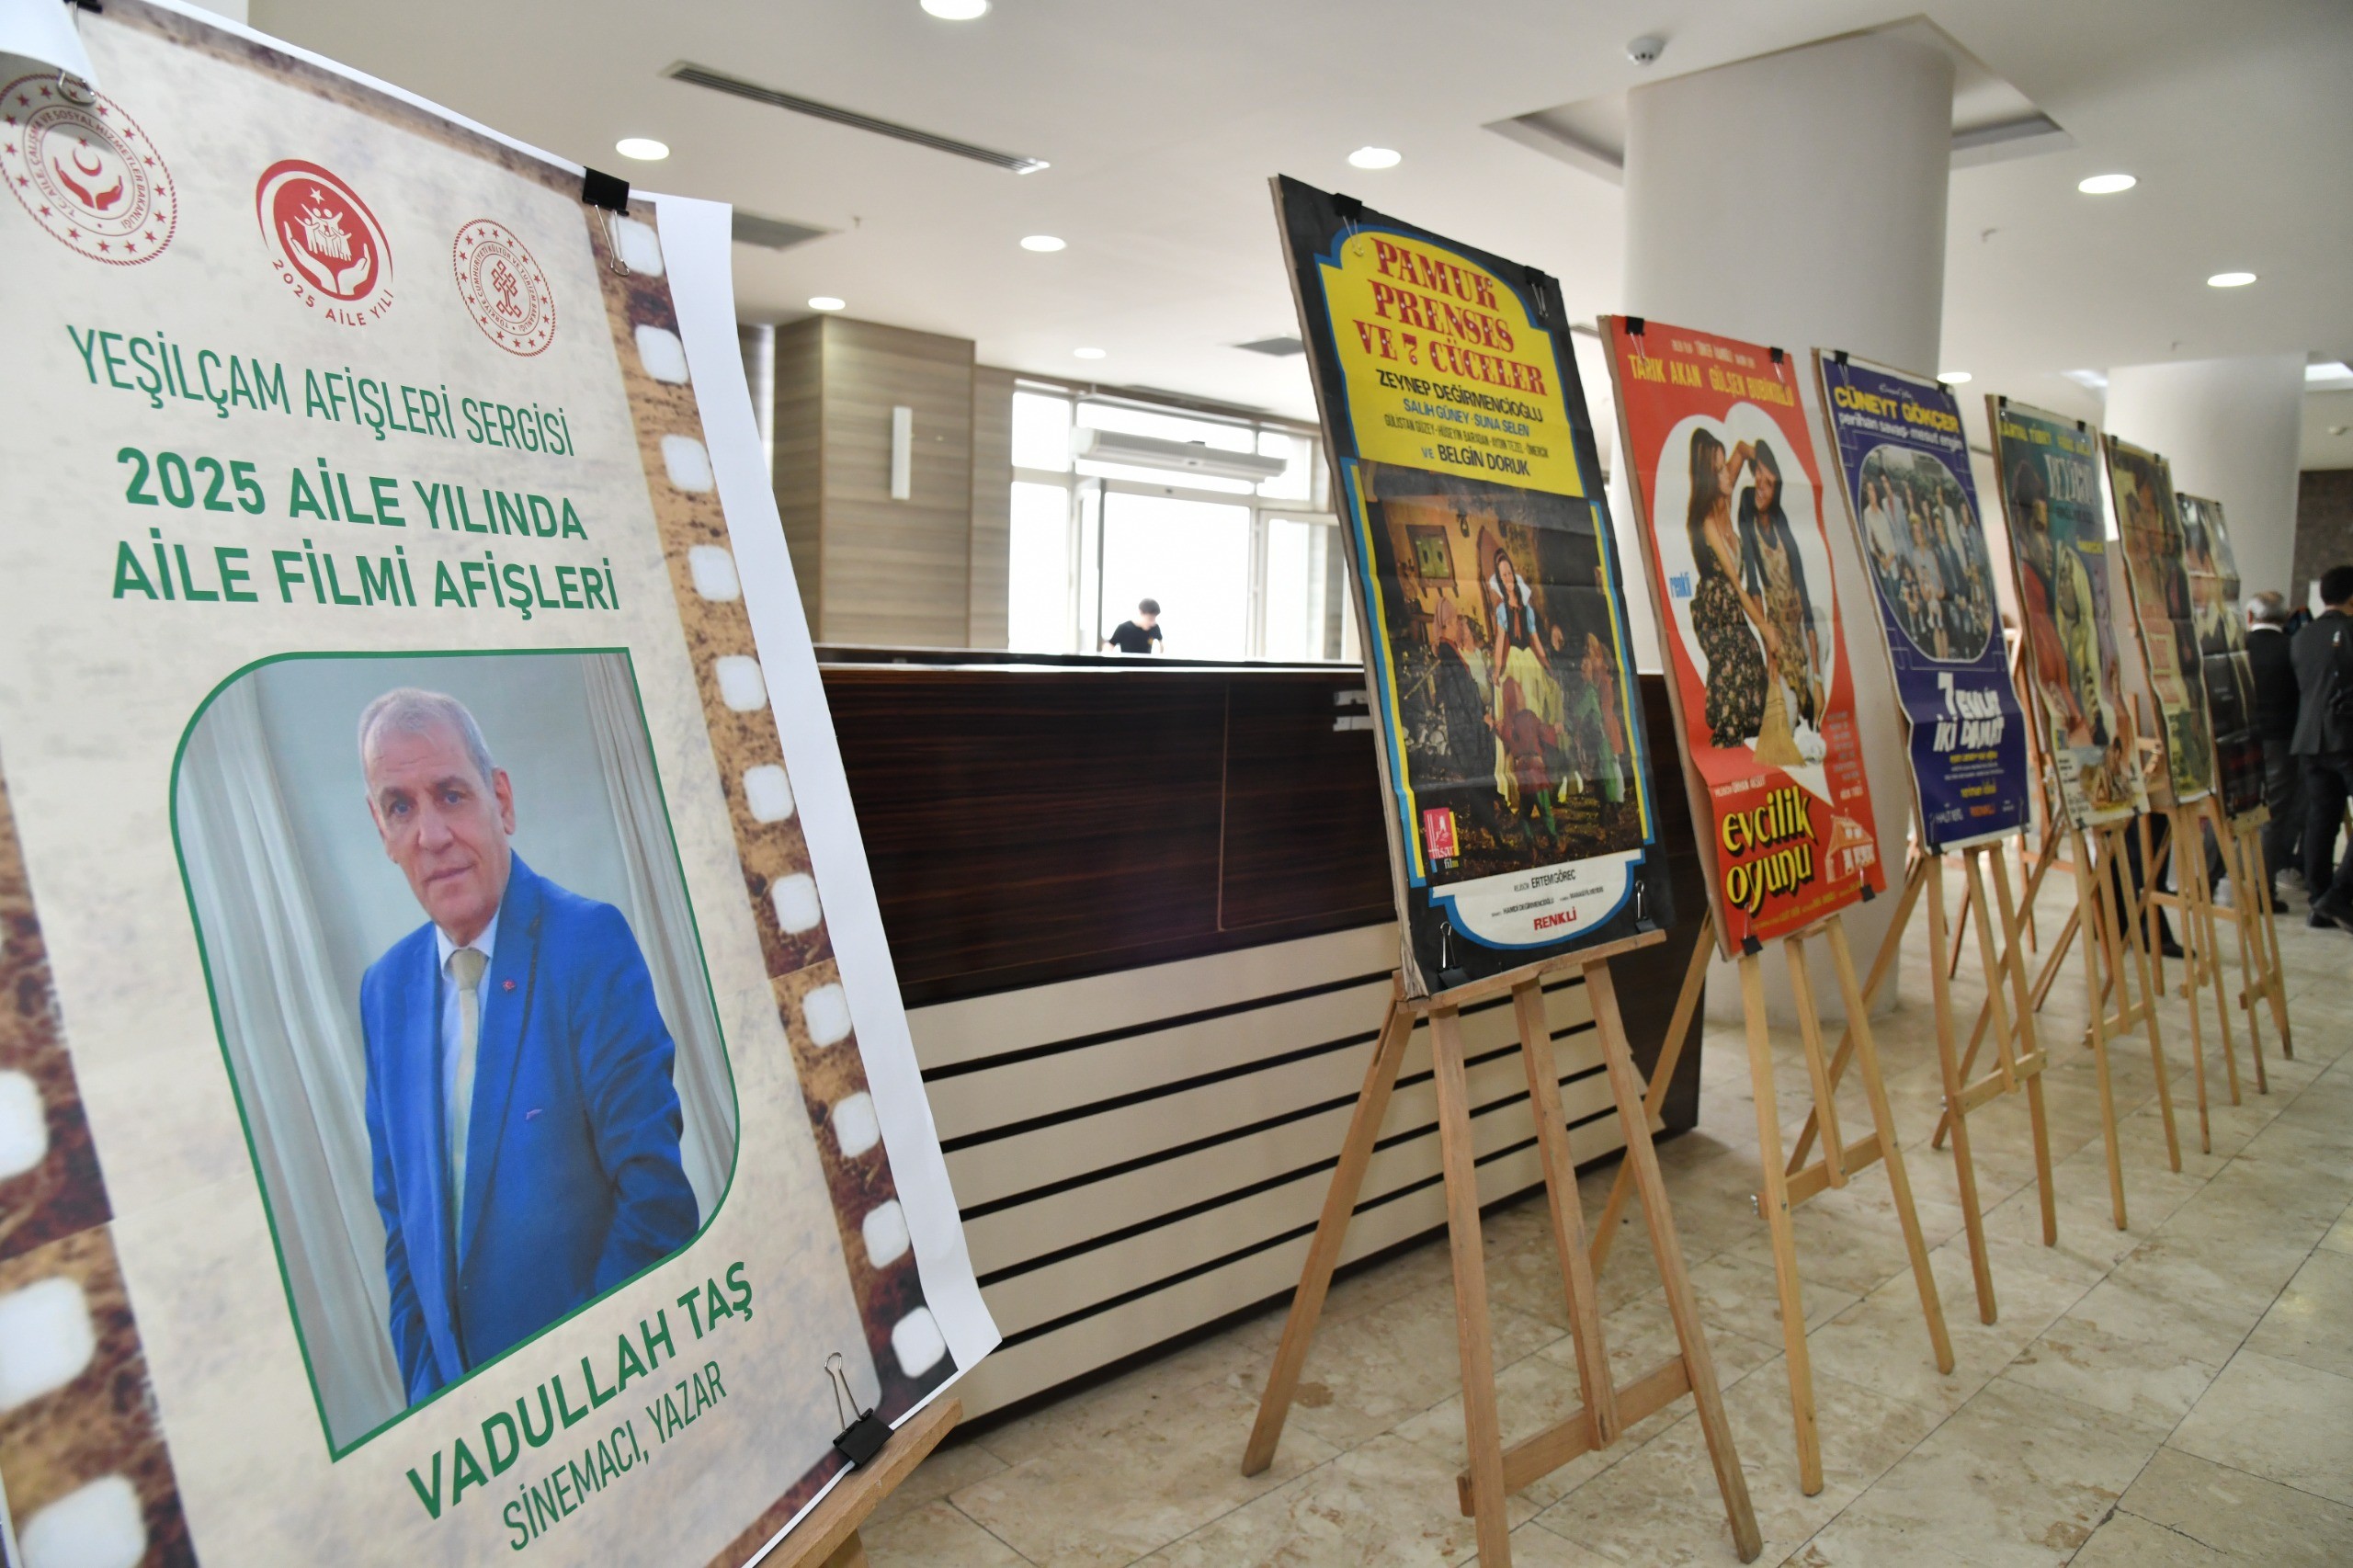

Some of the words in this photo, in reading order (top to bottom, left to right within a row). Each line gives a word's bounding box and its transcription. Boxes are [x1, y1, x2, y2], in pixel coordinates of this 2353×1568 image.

[53, 109, 94, 129] SOSYAL
[96, 124, 143, 181] HİZMETLER
[120, 182, 147, 229] BAKANLIĞI
[272, 259, 315, 308] 2025
[325, 308, 367, 326] AİLE
[369, 289, 394, 319] YILI
[1370, 237, 1499, 311] PAMUK
[1367, 278, 1515, 353] PRENSES
[66, 324, 291, 419] YEŞİLÇAM
[305, 366, 457, 441] AFİŞLERİ
[461, 397, 574, 456] SERGİSİ
[1353, 319, 1398, 362] VE
[1403, 332, 1419, 366] 7
[1427, 338, 1548, 396] CÜCELER
[1627, 354, 1666, 383] TARIK
[1669, 360, 1702, 388] AKAN
[1376, 369, 1431, 396] ZEYNEP
[1432, 381, 1543, 422] DEĞİRMENCİOĞLU
[1403, 398, 1435, 417] SALİH
[1436, 404, 1470, 423] GÜNEY
[1474, 414, 1500, 430] SUNA
[1503, 420, 1529, 437] SELEN
[1834, 384, 1899, 420] CÜNEYT
[117, 447, 266, 515] 2025
[290, 457, 406, 527] AİLE
[412, 480, 588, 540] YILINDA
[1438, 444, 1484, 467] BELGİN
[1486, 452, 1530, 476] DORUK
[112, 527, 259, 602] AİLE
[271, 538, 417, 607] FİLMİ
[435, 550, 620, 620] AFİŞLERİ
[1669, 572, 1692, 598] renkli
[1722, 786, 1816, 855] evcilik
[1530, 874, 1554, 889] ERTEM
[1726, 843, 1813, 915] oyunu
[1533, 906, 1577, 931] RENKLİ
[405, 1309, 676, 1520] VADULLAH
[676, 1261, 754, 1339] TAŞ
[503, 1420, 650, 1551] SİNEMACI,
[645, 1360, 727, 1445] YAZAR
